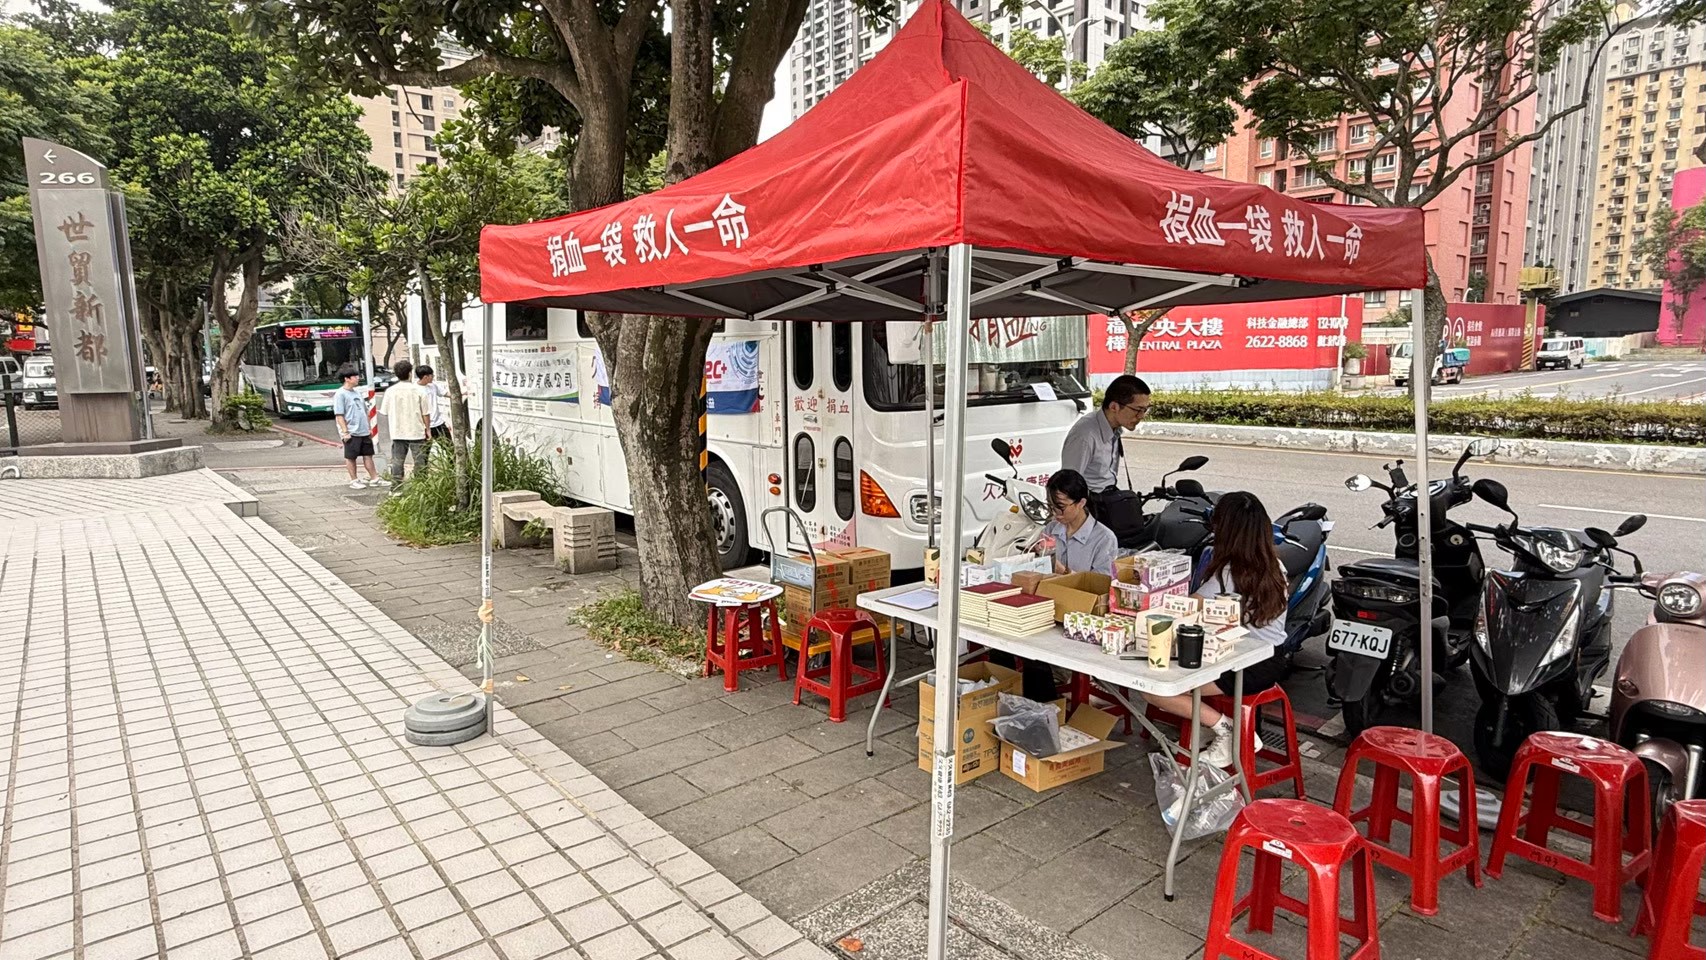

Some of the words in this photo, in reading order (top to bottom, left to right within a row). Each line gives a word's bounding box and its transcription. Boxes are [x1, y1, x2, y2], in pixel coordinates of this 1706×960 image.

[39, 172, 95, 185] 266
[547, 221, 626, 277] 捐血一袋
[633, 193, 750, 263] 救人一命
[1159, 191, 1273, 253] 捐血一袋
[1281, 208, 1363, 264] 救人一命
[57, 211, 107, 363] 世貿新都
[1133, 318, 1223, 337] 央大樓
[1138, 341, 1181, 350] ENTRAL
[1187, 340, 1222, 349] PLAZA
[1245, 335, 1308, 348] 2622-8868
[794, 397, 818, 412] 歡迎
[827, 397, 850, 413] 捐血
[1331, 629, 1388, 653] 677-KQJ
